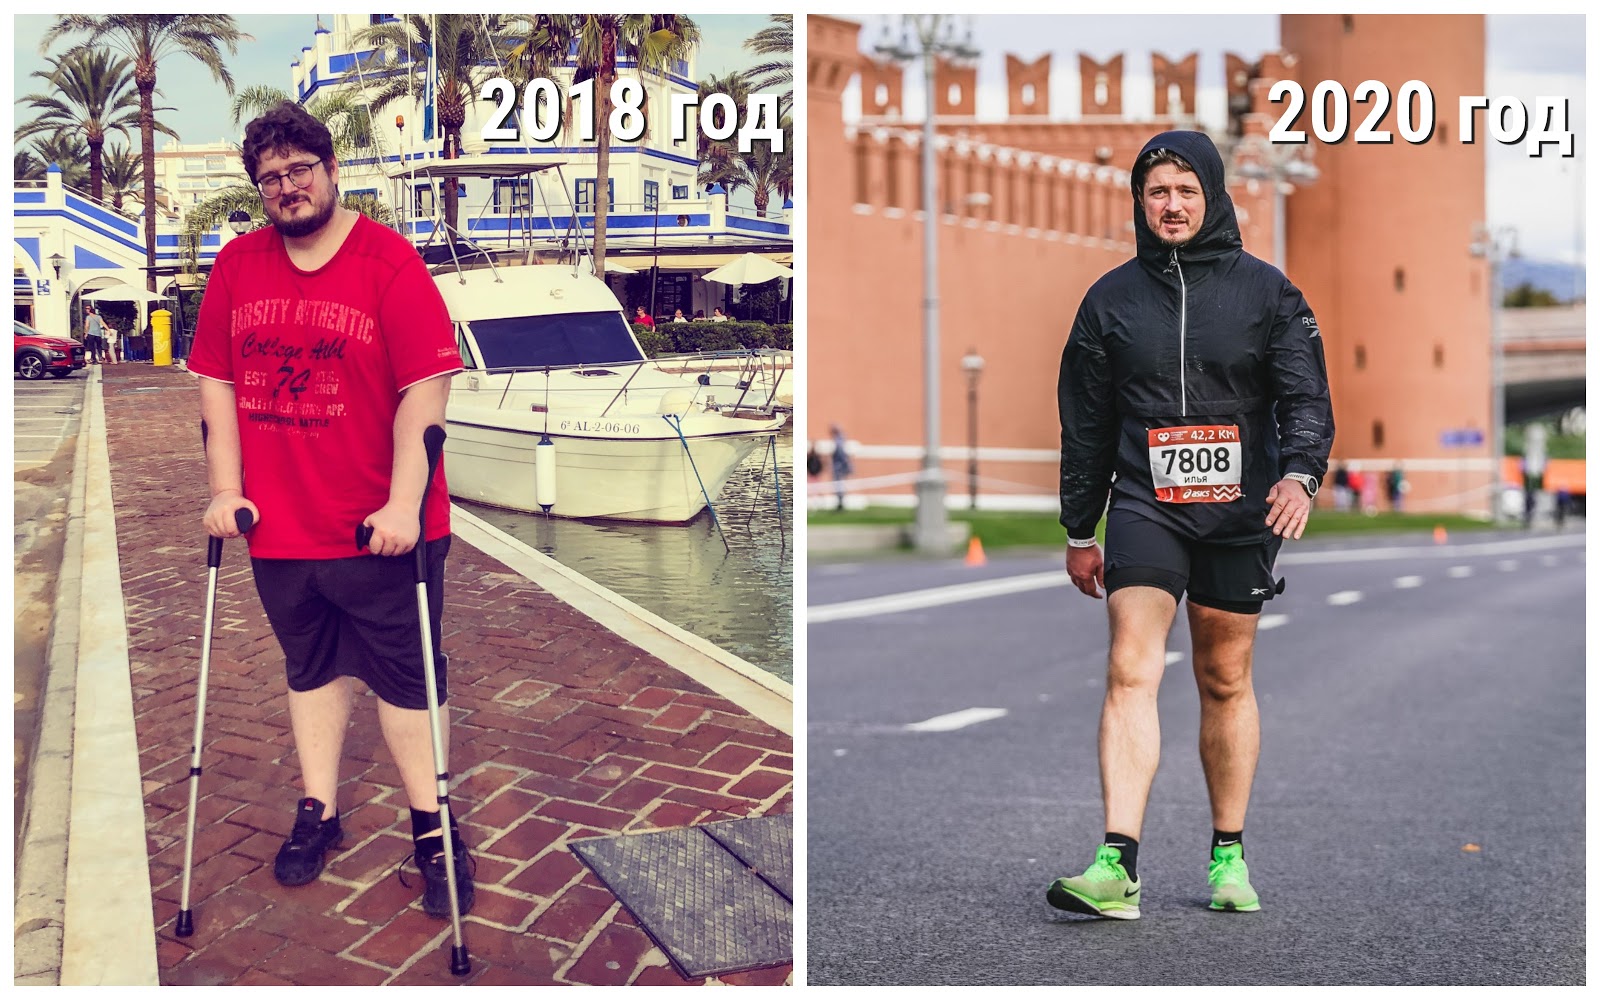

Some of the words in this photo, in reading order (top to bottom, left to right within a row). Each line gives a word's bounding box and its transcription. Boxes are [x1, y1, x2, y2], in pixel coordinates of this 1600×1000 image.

[244, 370, 267, 386] EST
[273, 366, 311, 400] 74
[573, 421, 640, 434] AL-2-06-06
[1190, 429, 1215, 441] 42,2
[1161, 446, 1231, 475] 7808
[1184, 475, 1208, 484] ИЛЬЯ
